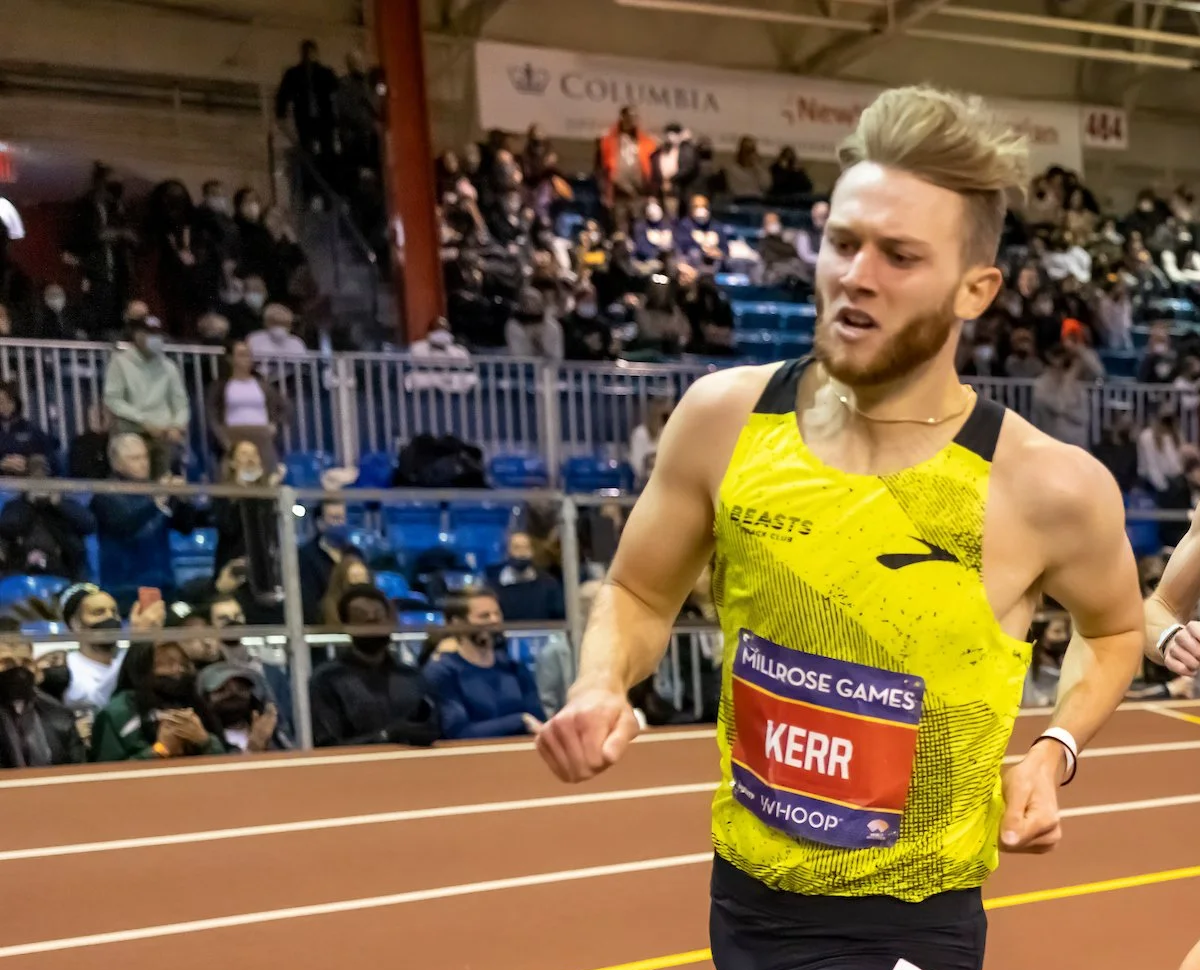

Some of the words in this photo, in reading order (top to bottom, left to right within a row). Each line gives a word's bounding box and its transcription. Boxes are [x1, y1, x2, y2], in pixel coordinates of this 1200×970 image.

[559, 72, 720, 113] COLUMBIA
[730, 505, 814, 536] BEASTS
[736, 523, 767, 537] ACK
[771, 532, 793, 543] CLUB
[741, 648, 832, 694] MILLROSE
[836, 678, 916, 711] GAMES
[764, 719, 854, 780] KERR
[759, 794, 840, 832] WHOOP
